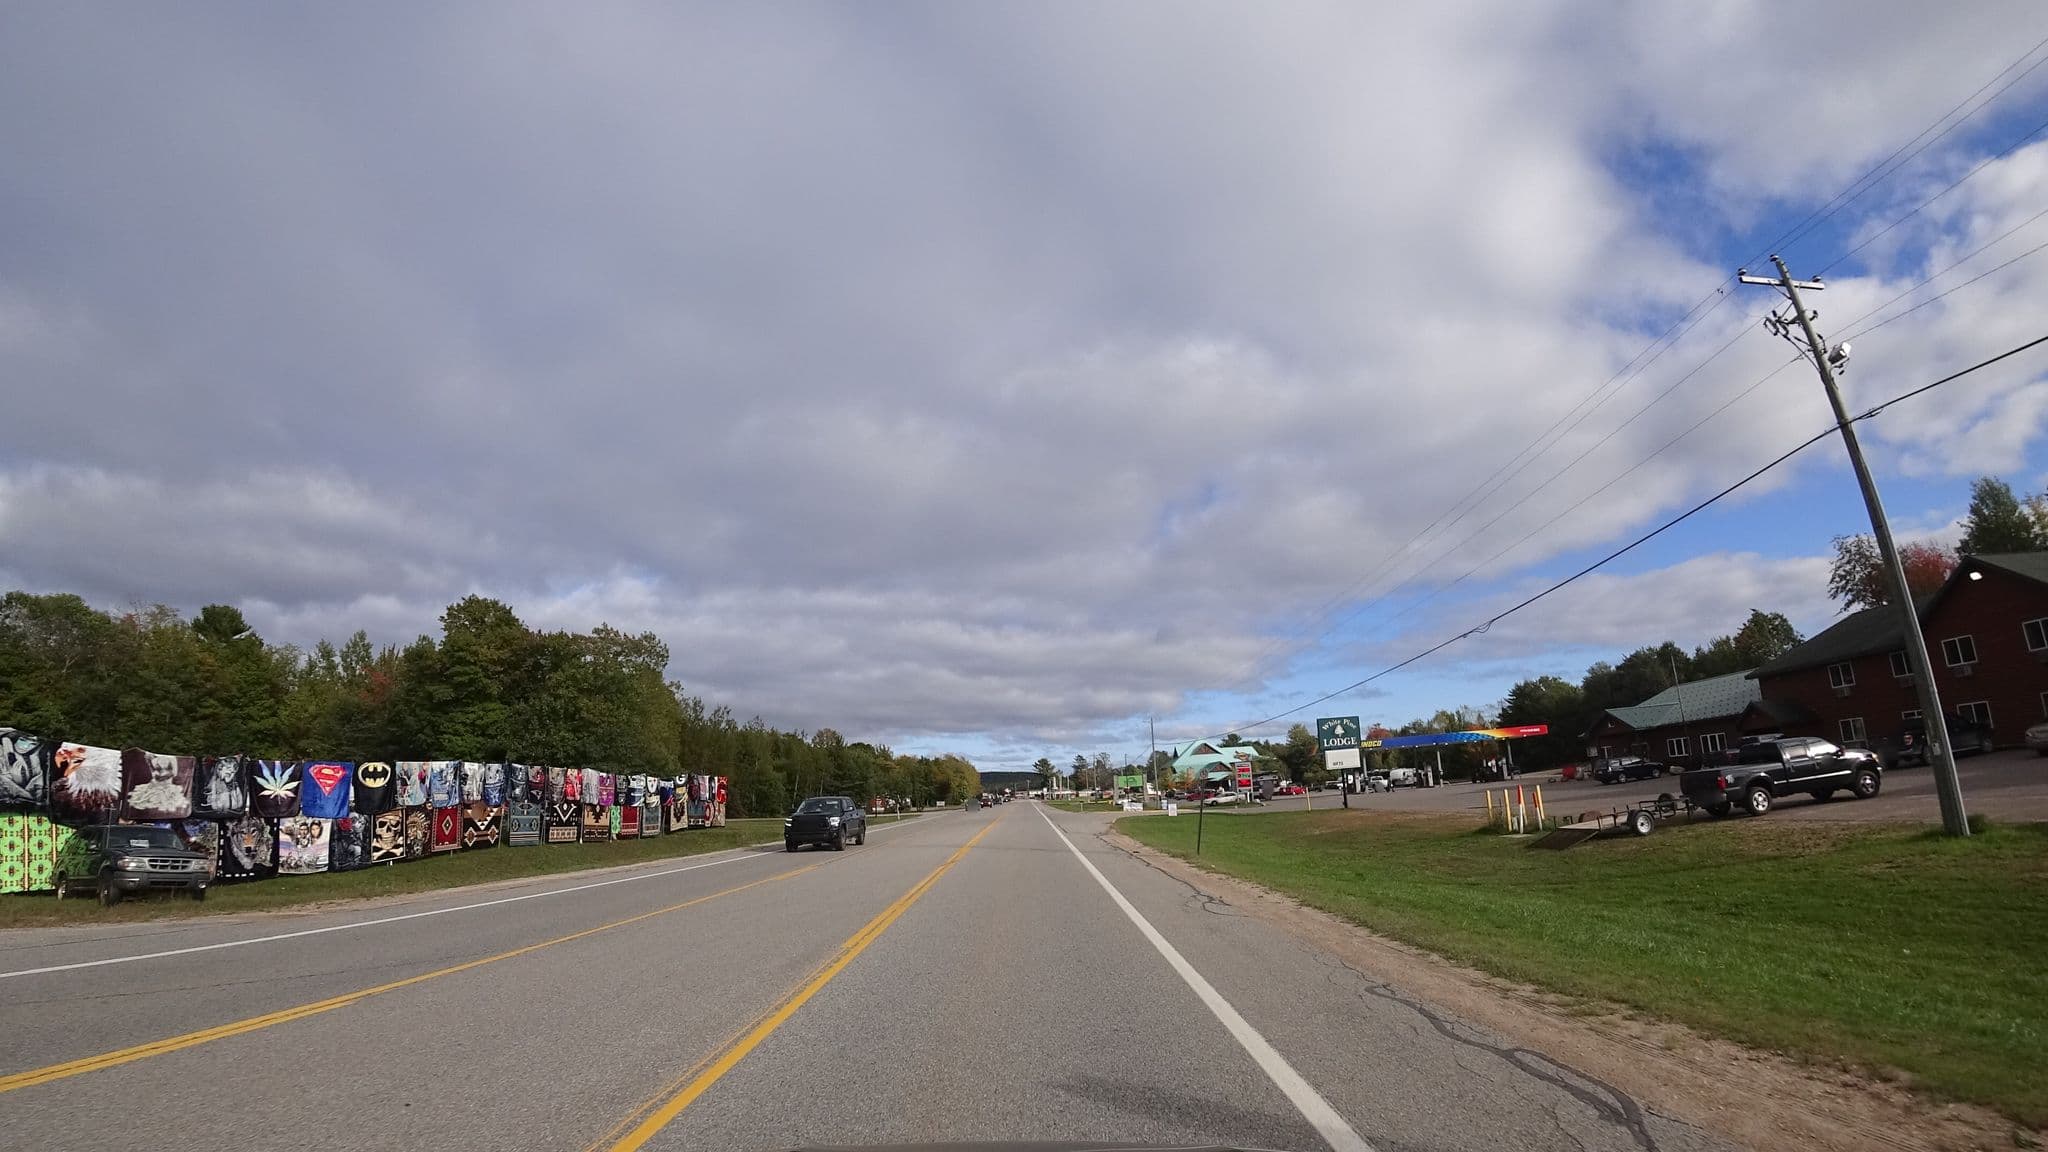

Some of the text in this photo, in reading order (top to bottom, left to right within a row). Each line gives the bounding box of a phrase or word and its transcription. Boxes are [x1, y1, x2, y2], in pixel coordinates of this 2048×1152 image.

[1322, 718, 1357, 730] White Pine
[1324, 737, 1357, 747] LODGE
